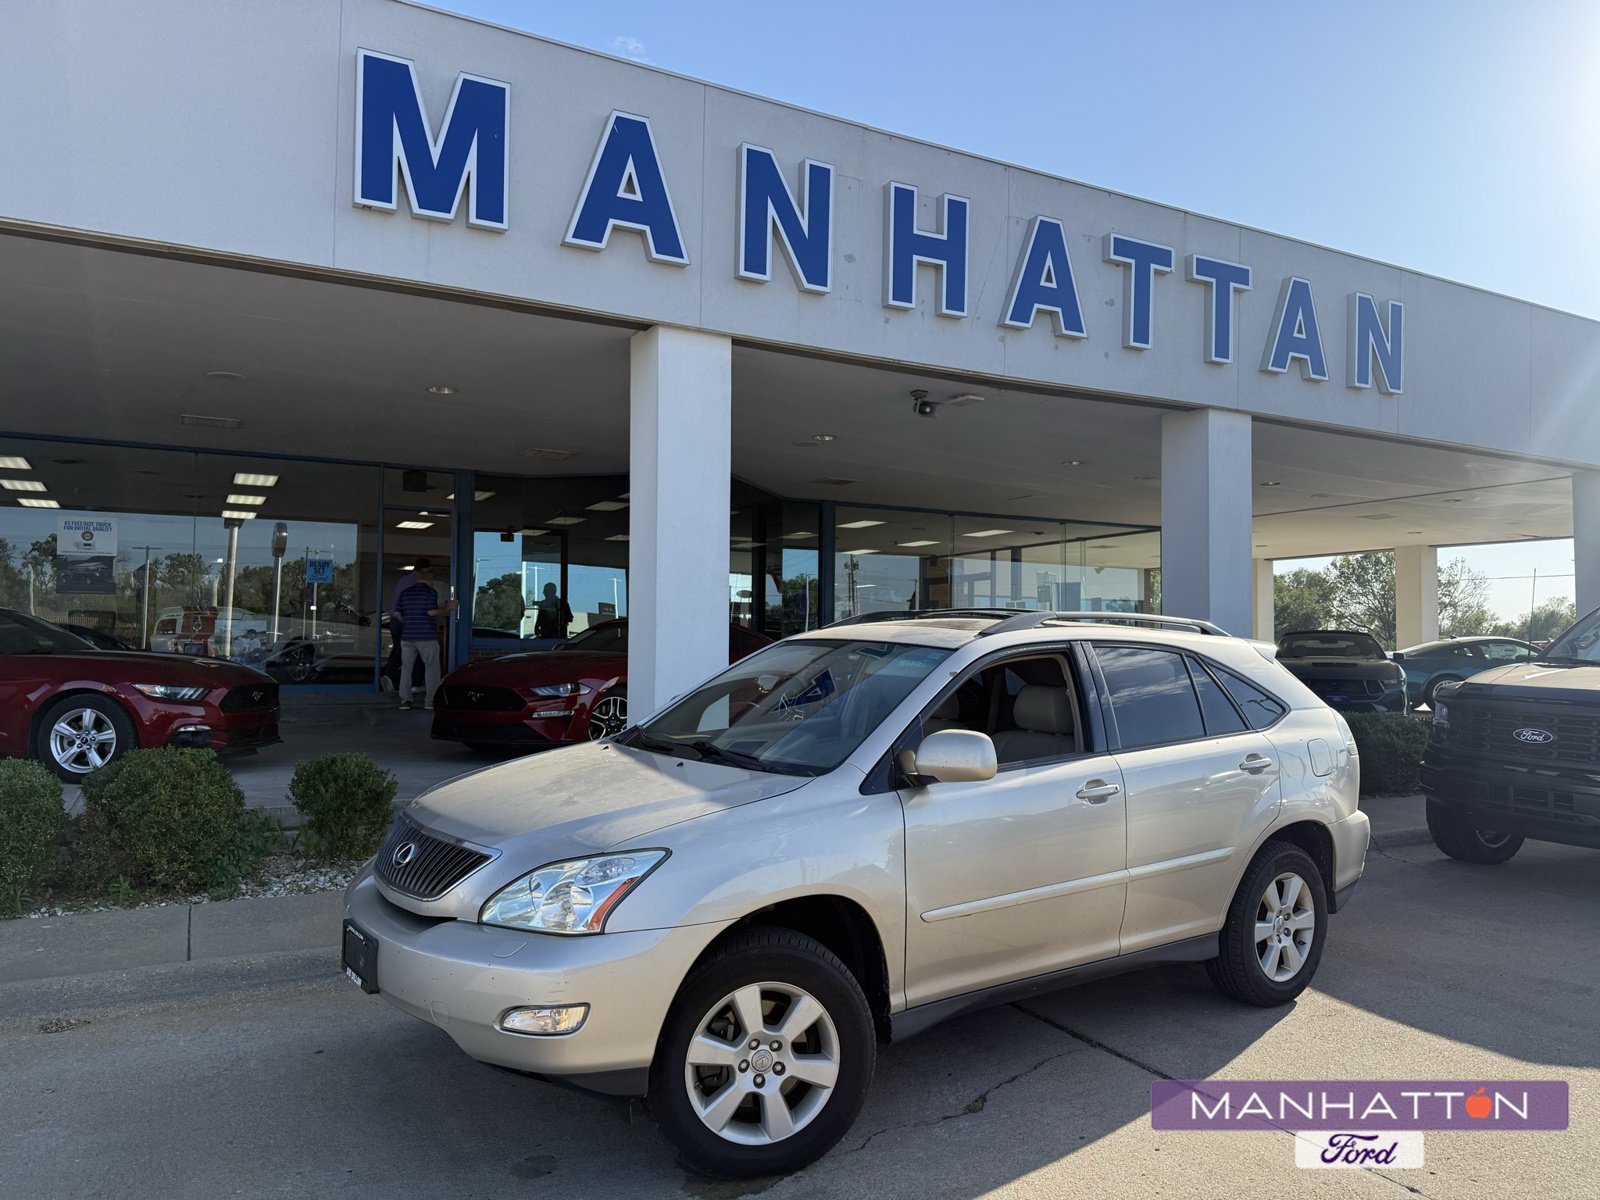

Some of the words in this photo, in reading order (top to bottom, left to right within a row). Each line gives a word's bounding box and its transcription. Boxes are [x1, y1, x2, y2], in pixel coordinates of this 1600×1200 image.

[353, 47, 1405, 395] MANHATTAN
[309, 560, 330, 568] READY
[1520, 730, 1545, 741] Ford
